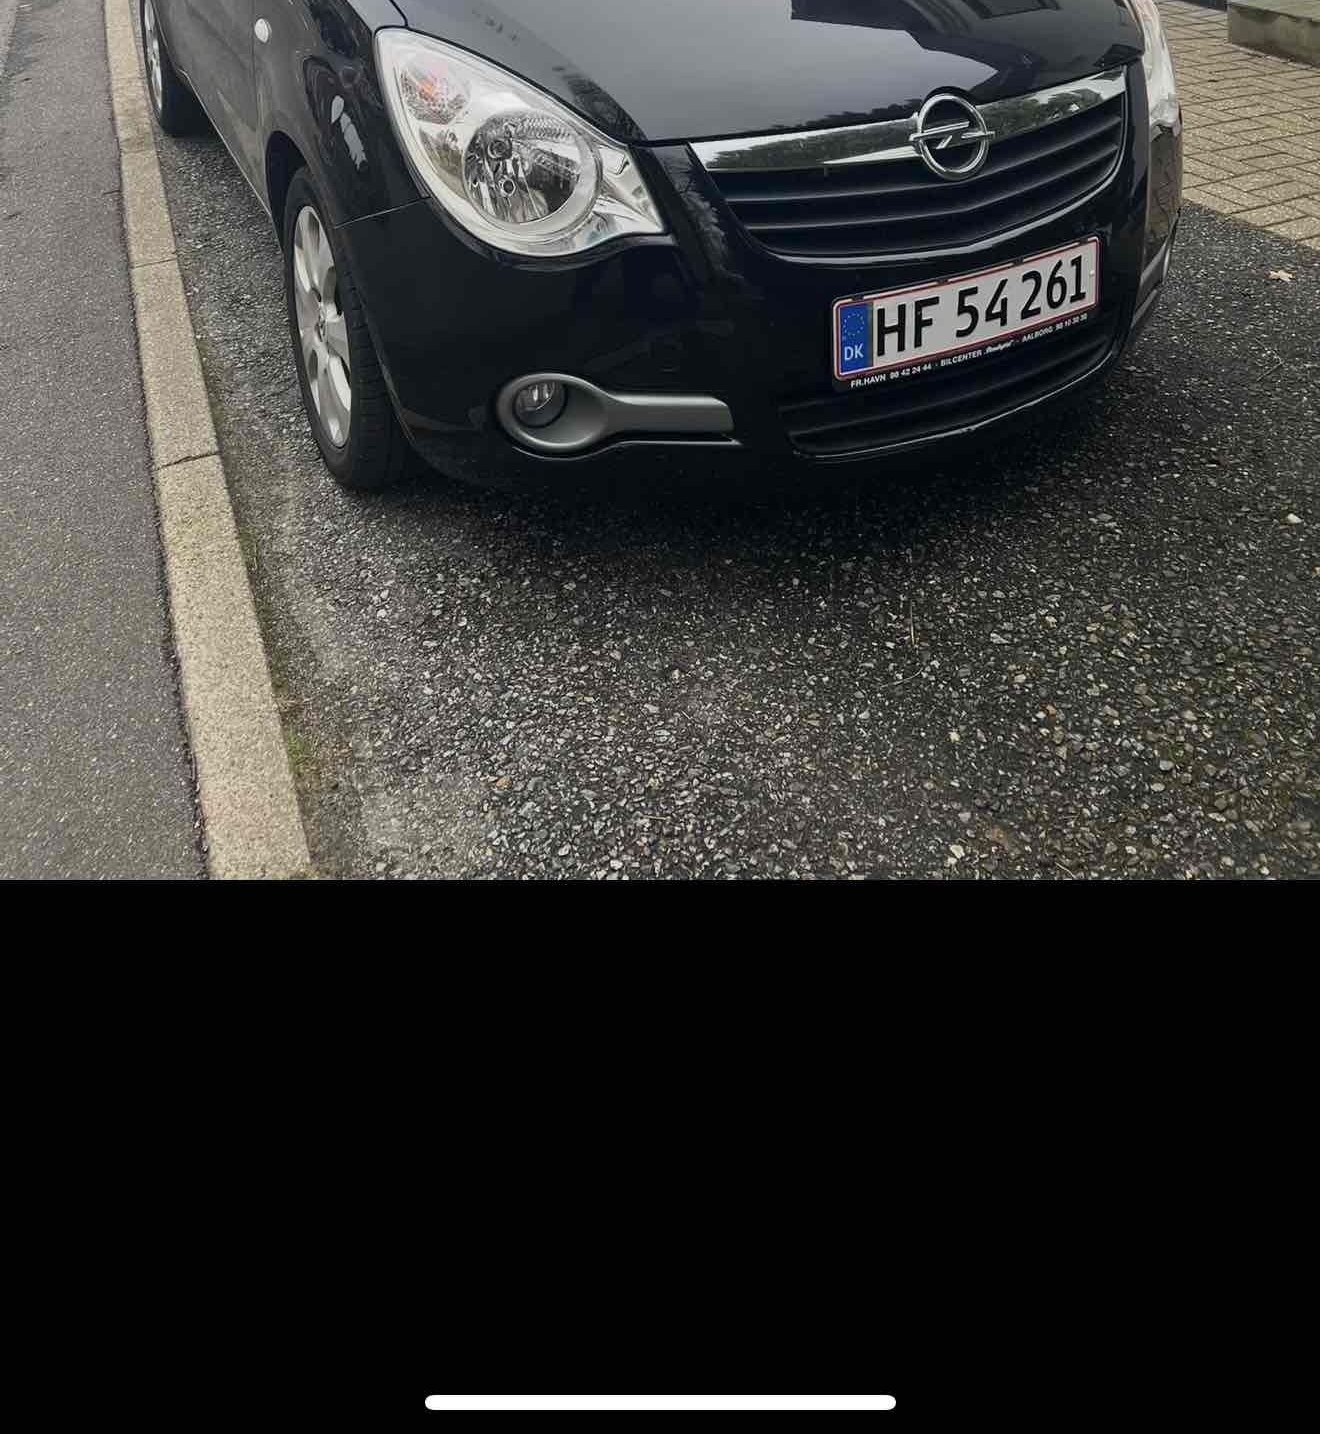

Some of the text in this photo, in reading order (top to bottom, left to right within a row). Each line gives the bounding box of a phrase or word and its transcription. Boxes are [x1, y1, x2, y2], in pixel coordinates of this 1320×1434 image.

[877, 255, 1086, 356] HF 54 261
[844, 343, 864, 362] DK
[851, 374, 886, 388] FR.HAVN
[940, 349, 982, 367] BILCENTER
[1022, 326, 1053, 342] AALBORG
